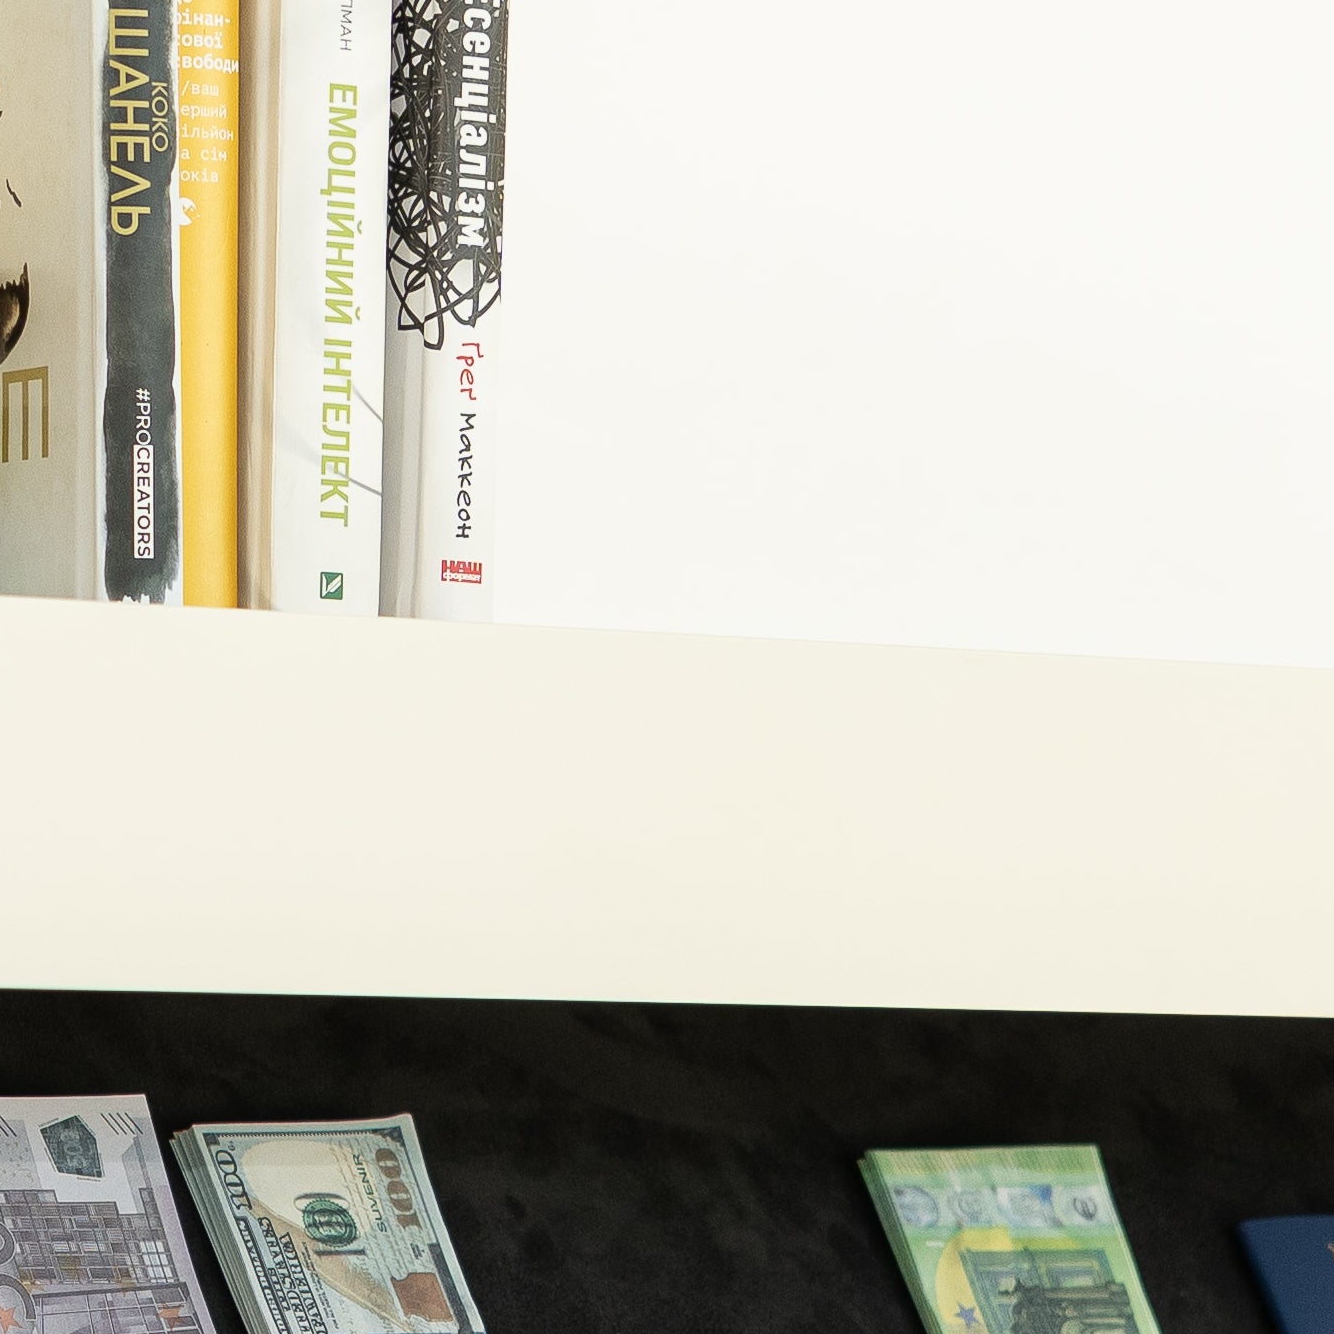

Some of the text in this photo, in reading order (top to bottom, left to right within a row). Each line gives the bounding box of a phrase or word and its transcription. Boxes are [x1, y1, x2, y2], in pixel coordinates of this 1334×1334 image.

[108, 8, 152, 236] ШАНЕЛЬ
[151, 81, 169, 153] КОКО
[180, 104, 227, 119] ерший
[180, 123, 234, 142] ільйон
[180, 148, 190, 160] а
[180, 168, 219, 183] оків
[319, 82, 362, 527] ЕМОЦІЙНИЙ ІНТЕЛЕКТ
[134, 387, 153, 558] #PROCREATORS
[212, 1148, 254, 1210] 100
[350, 1153, 388, 1232] SUVENIR
[370, 1146, 423, 1231] 100
